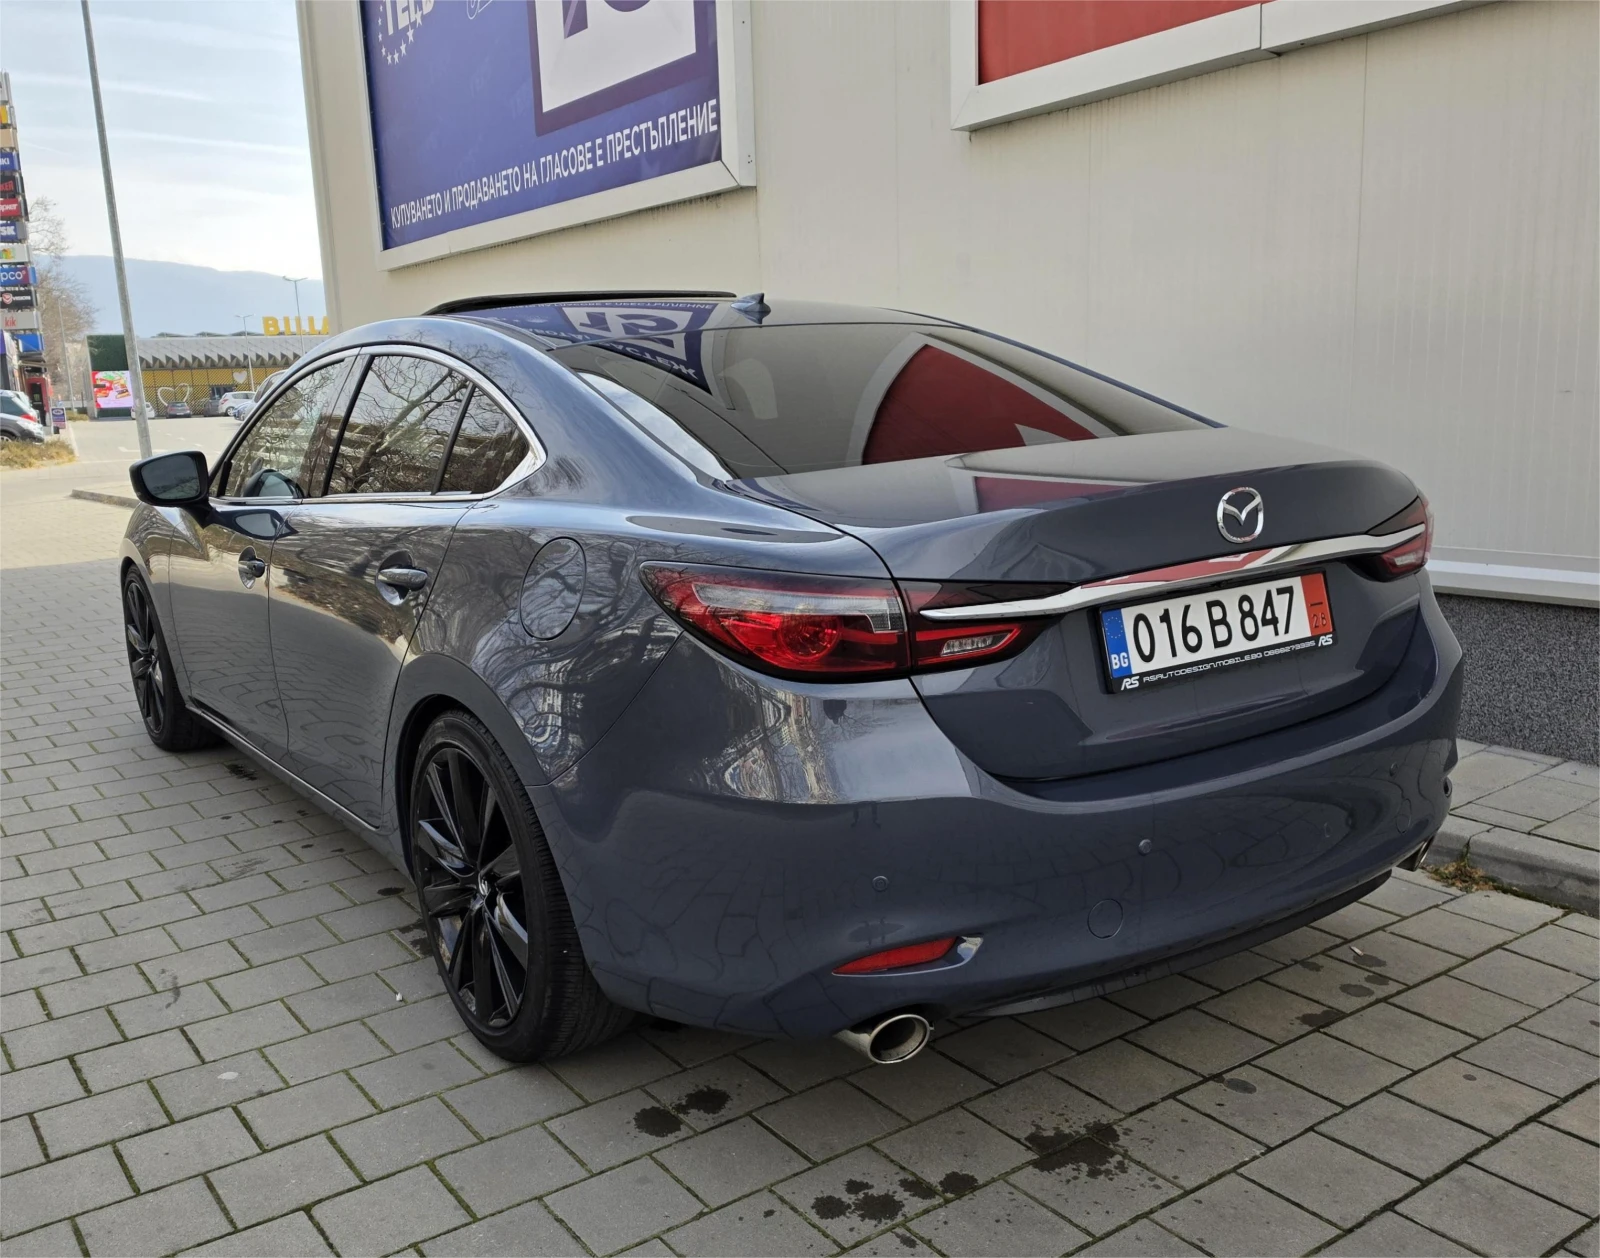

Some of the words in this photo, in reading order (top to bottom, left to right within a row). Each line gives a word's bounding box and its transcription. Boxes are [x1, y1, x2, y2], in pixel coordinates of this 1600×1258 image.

[390, 192, 442, 229] КУПУВАНЕТО
[443, 190, 451, 213] И
[452, 166, 520, 210] ПРОДАВАНЕТО
[523, 159, 538, 189] НА
[540, 140, 593, 184] ГЛАСОВЕ
[595, 137, 604, 167] Е
[606, 98, 718, 164] ПРЕСТЪПЛЕНИЕ
[1111, 652, 1129, 669] BG
[1121, 676, 1140, 691] RS
[1318, 635, 1333, 647] RS
